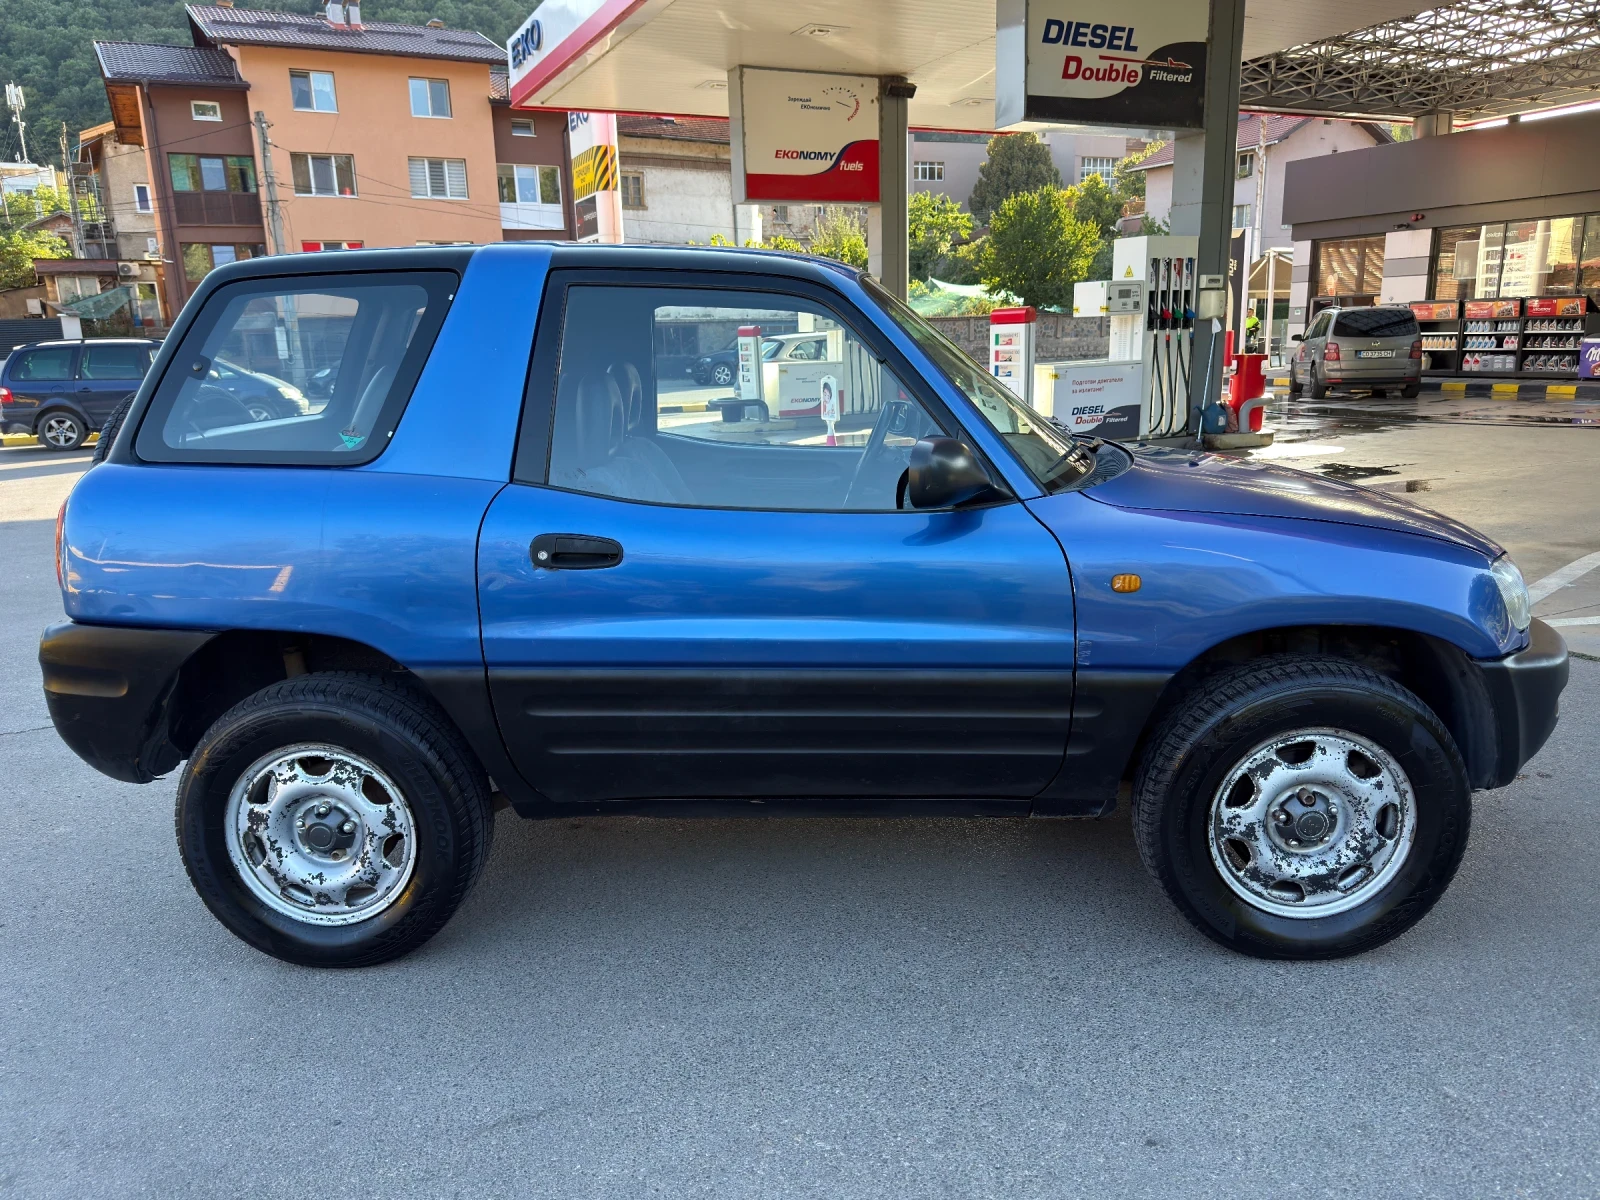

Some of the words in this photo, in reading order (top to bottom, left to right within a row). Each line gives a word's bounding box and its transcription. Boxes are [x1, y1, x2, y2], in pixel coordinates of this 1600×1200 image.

[511, 19, 543, 69] EKO
[1042, 18, 1138, 52] DIESEL
[1062, 55, 1139, 84] Double
[1150, 70, 1193, 83] Filtered
[774, 149, 837, 162] EKONOMY
[839, 161, 864, 172] fuels
[1071, 404, 1106, 416] DIESEL
[1075, 416, 1103, 425] Double
